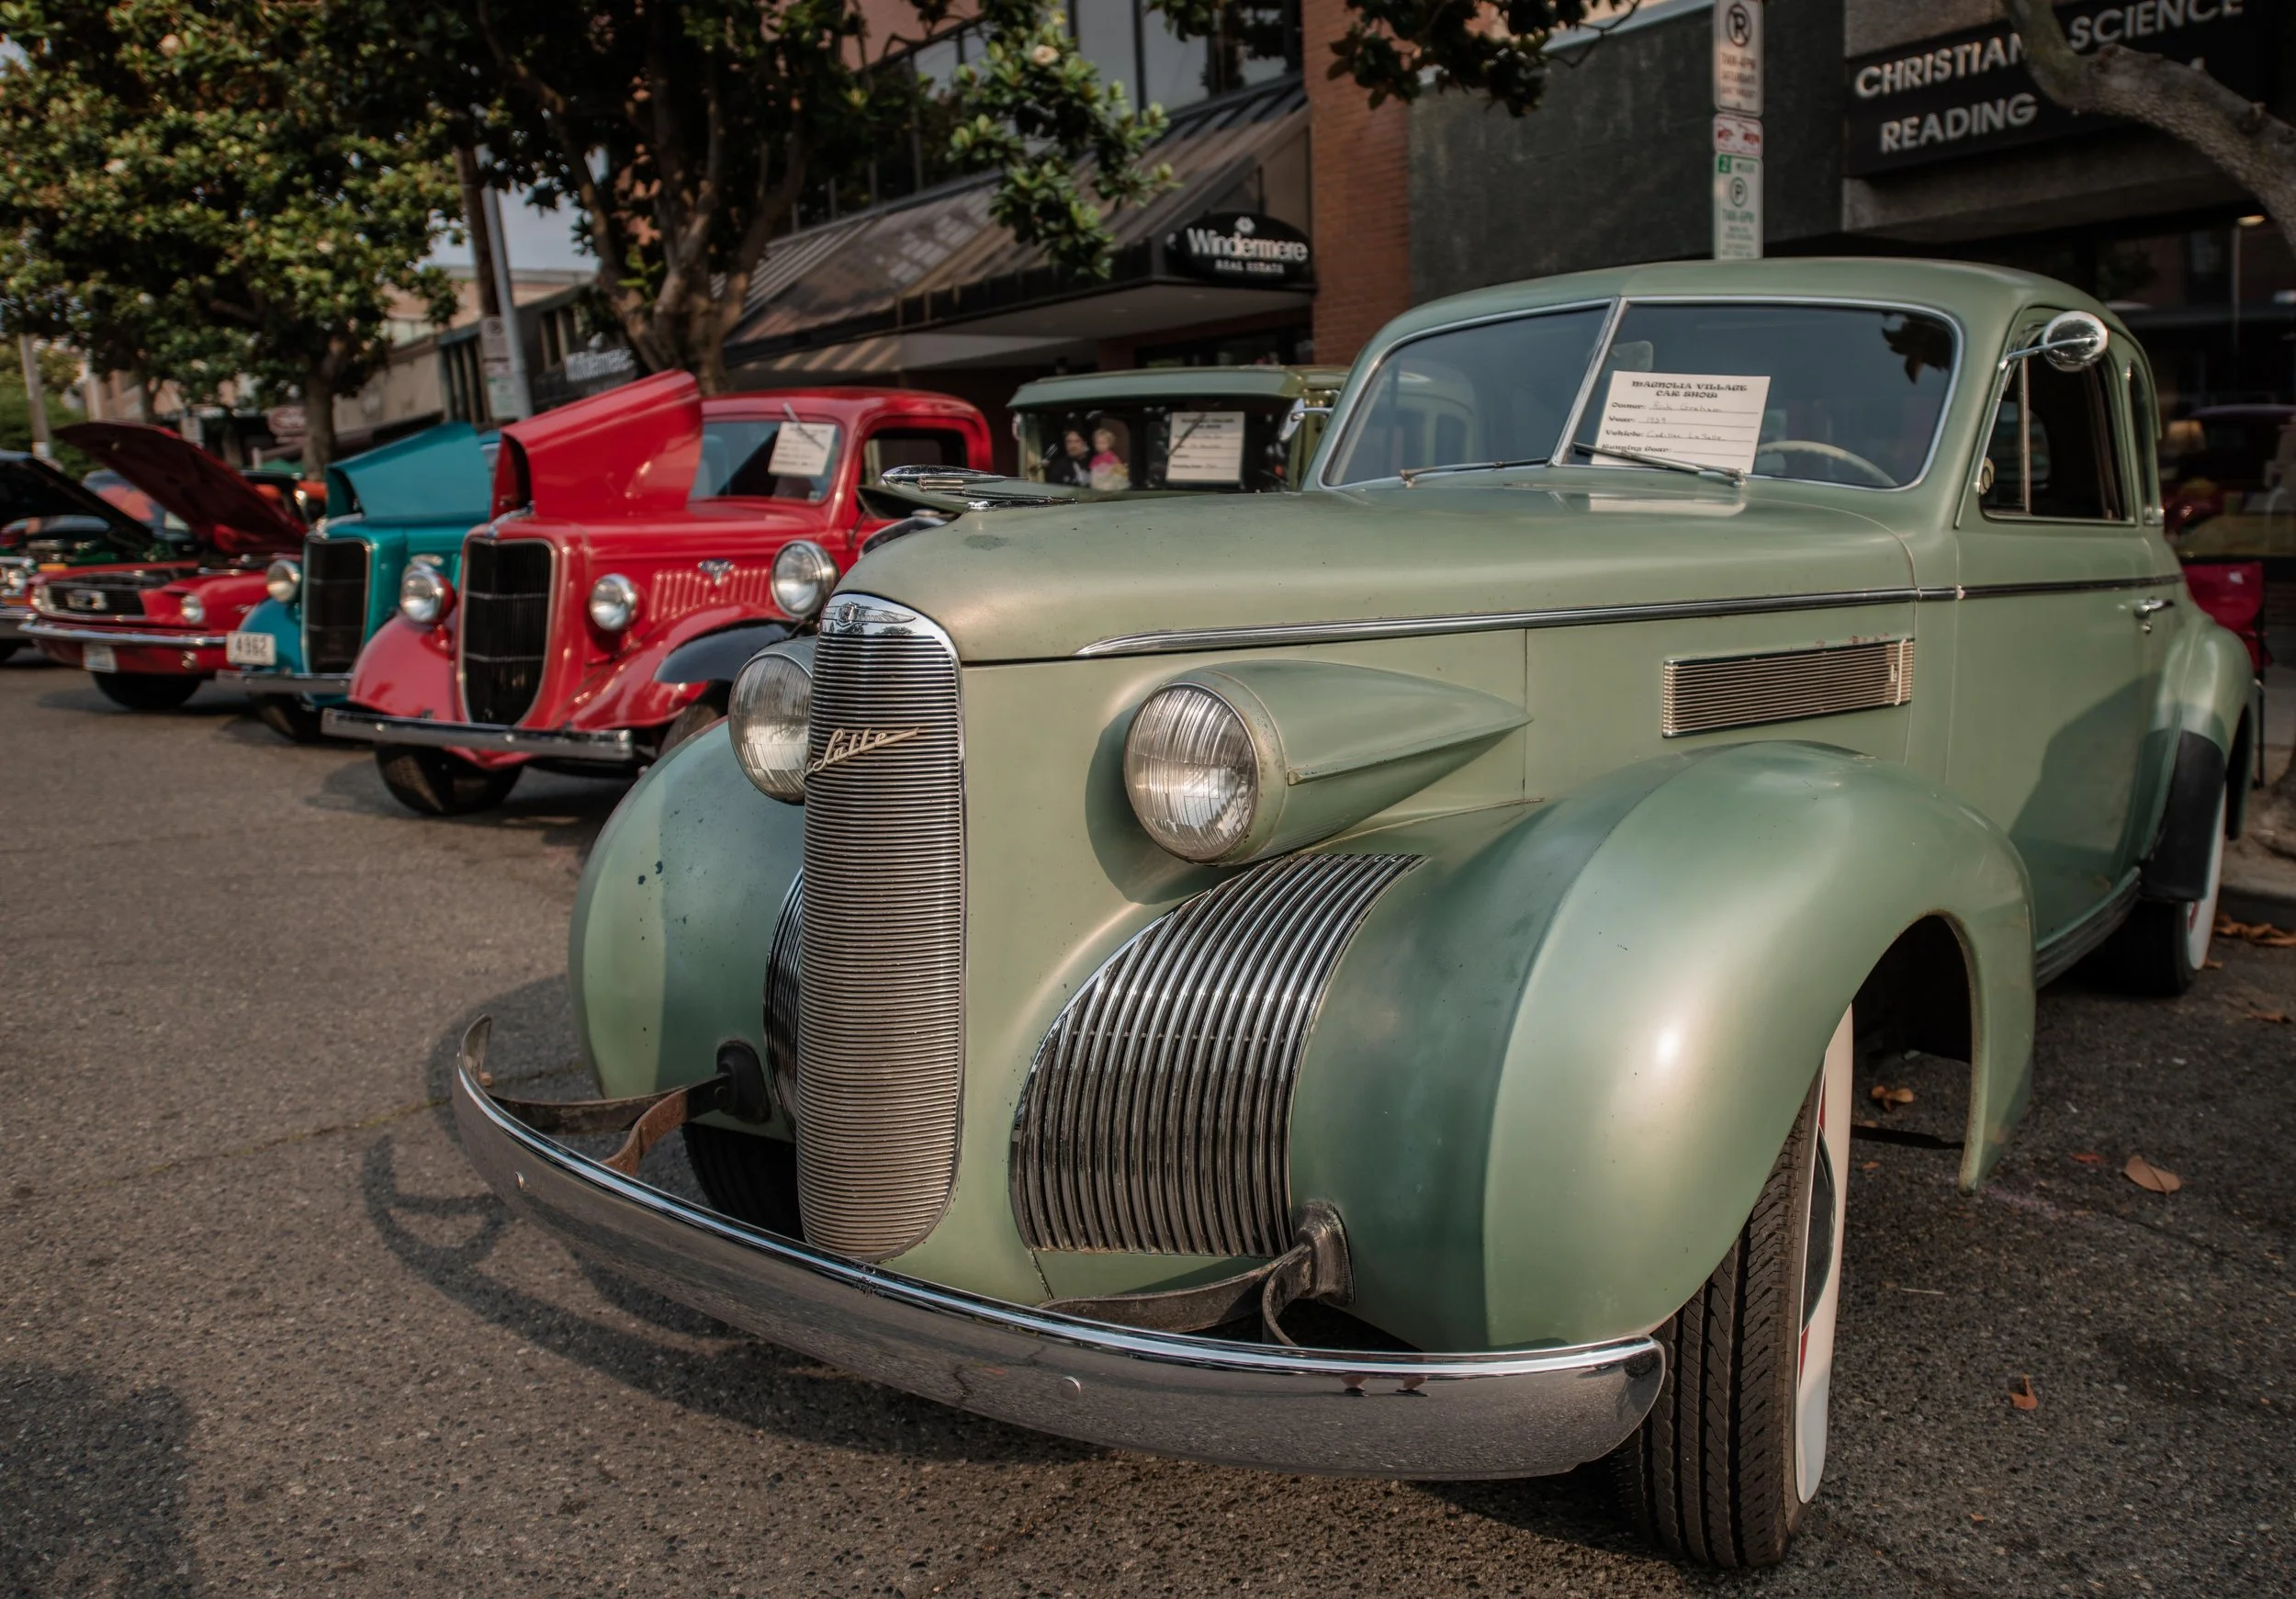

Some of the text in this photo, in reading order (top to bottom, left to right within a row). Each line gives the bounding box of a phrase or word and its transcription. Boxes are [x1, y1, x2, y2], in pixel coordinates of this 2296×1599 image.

[1855, 0, 2244, 98] CHRISTIAN SCIENCE
[1880, 94, 2038, 154] READING
[1187, 227, 1309, 262] Windermere
[1215, 260, 1285, 274] REAL ESTATE
[1631, 380, 1748, 391] MAGNOLIA VILLAGE
[1683, 390, 1718, 399] SHOW
